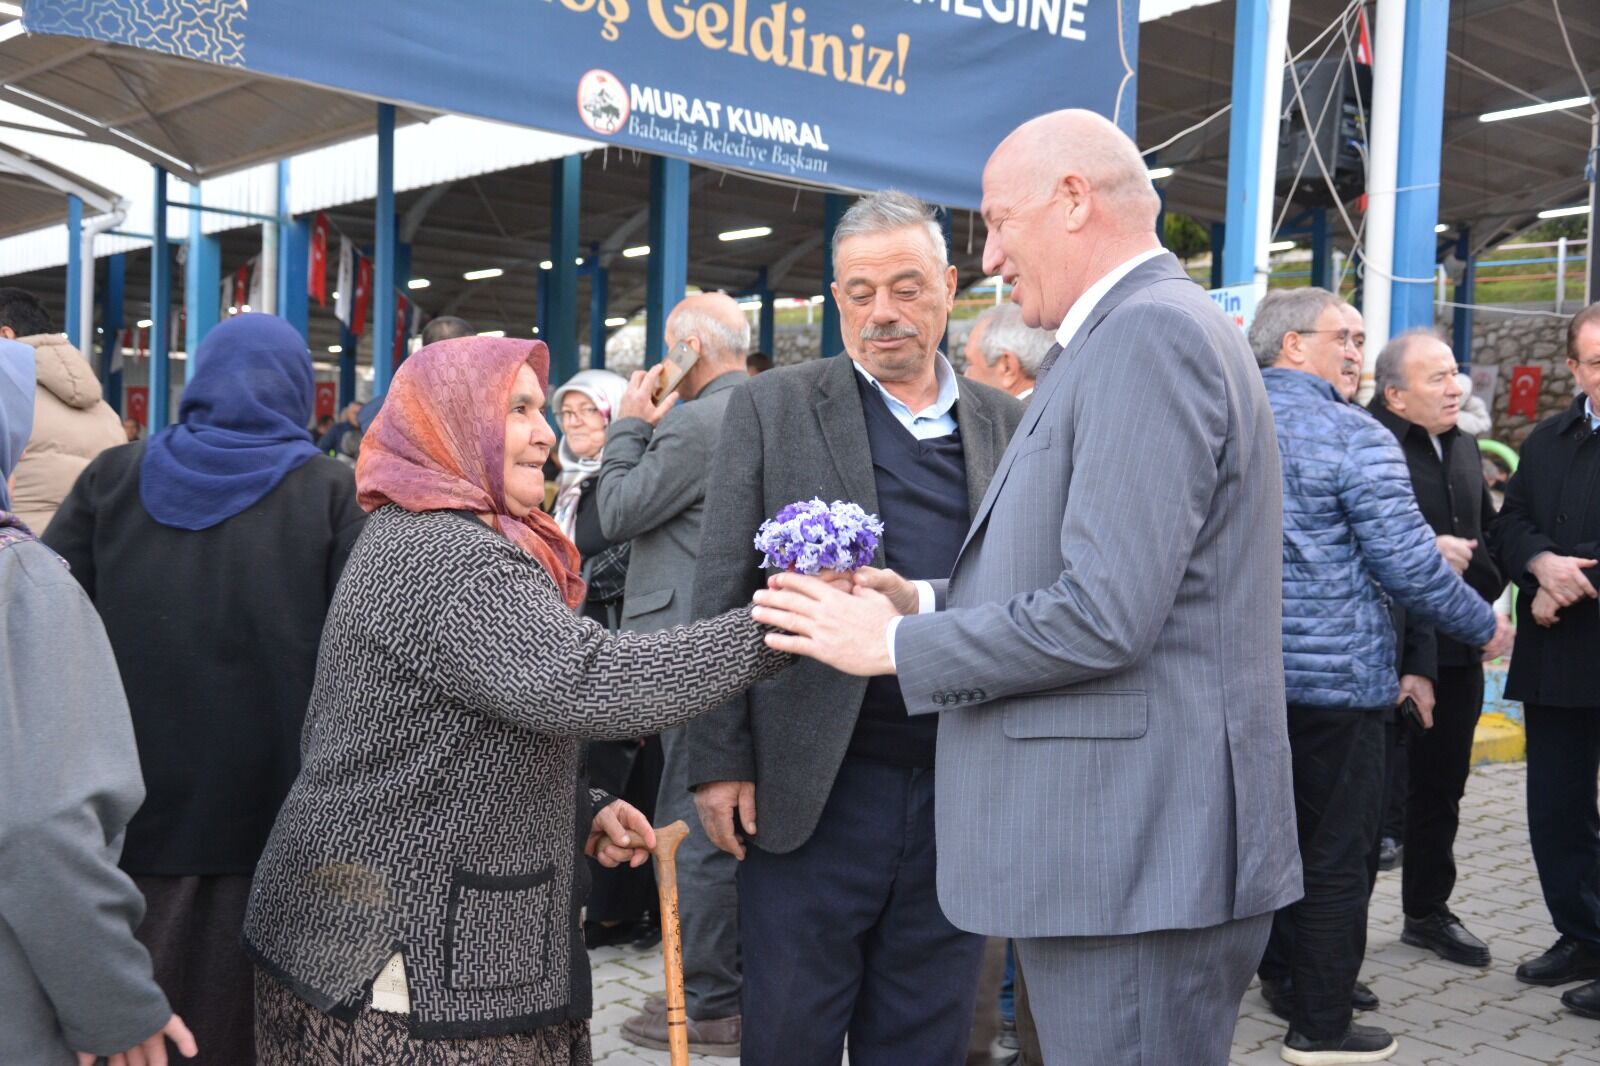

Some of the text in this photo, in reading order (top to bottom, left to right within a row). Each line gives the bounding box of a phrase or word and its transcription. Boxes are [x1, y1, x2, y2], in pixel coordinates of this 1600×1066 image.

[648, 0, 910, 95] Geldiniz!
[628, 115, 829, 173] Babadağ Belediye Başkanı
[630, 83, 830, 151] MURAT KUMRAL
